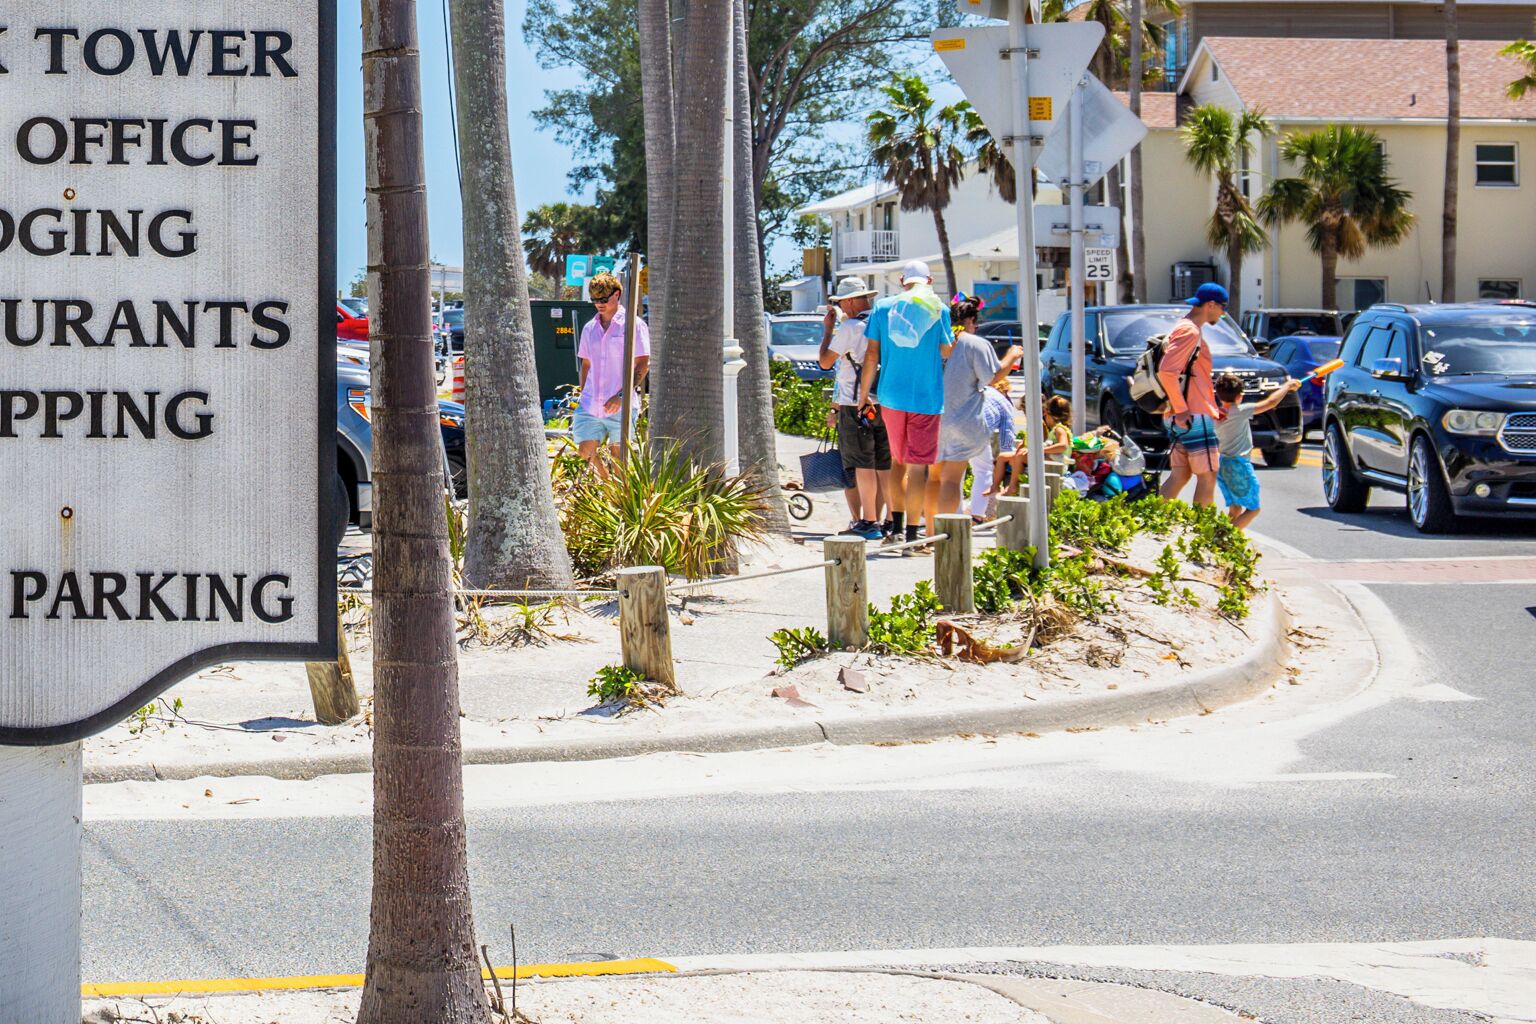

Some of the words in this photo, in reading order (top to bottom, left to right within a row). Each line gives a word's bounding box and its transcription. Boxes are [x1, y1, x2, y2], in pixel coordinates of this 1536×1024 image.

[35, 27, 298, 78] TOWER
[15, 115, 260, 167] OFFICE
[1087, 264, 1111, 278] 25
[9, 571, 295, 624] PARKING
